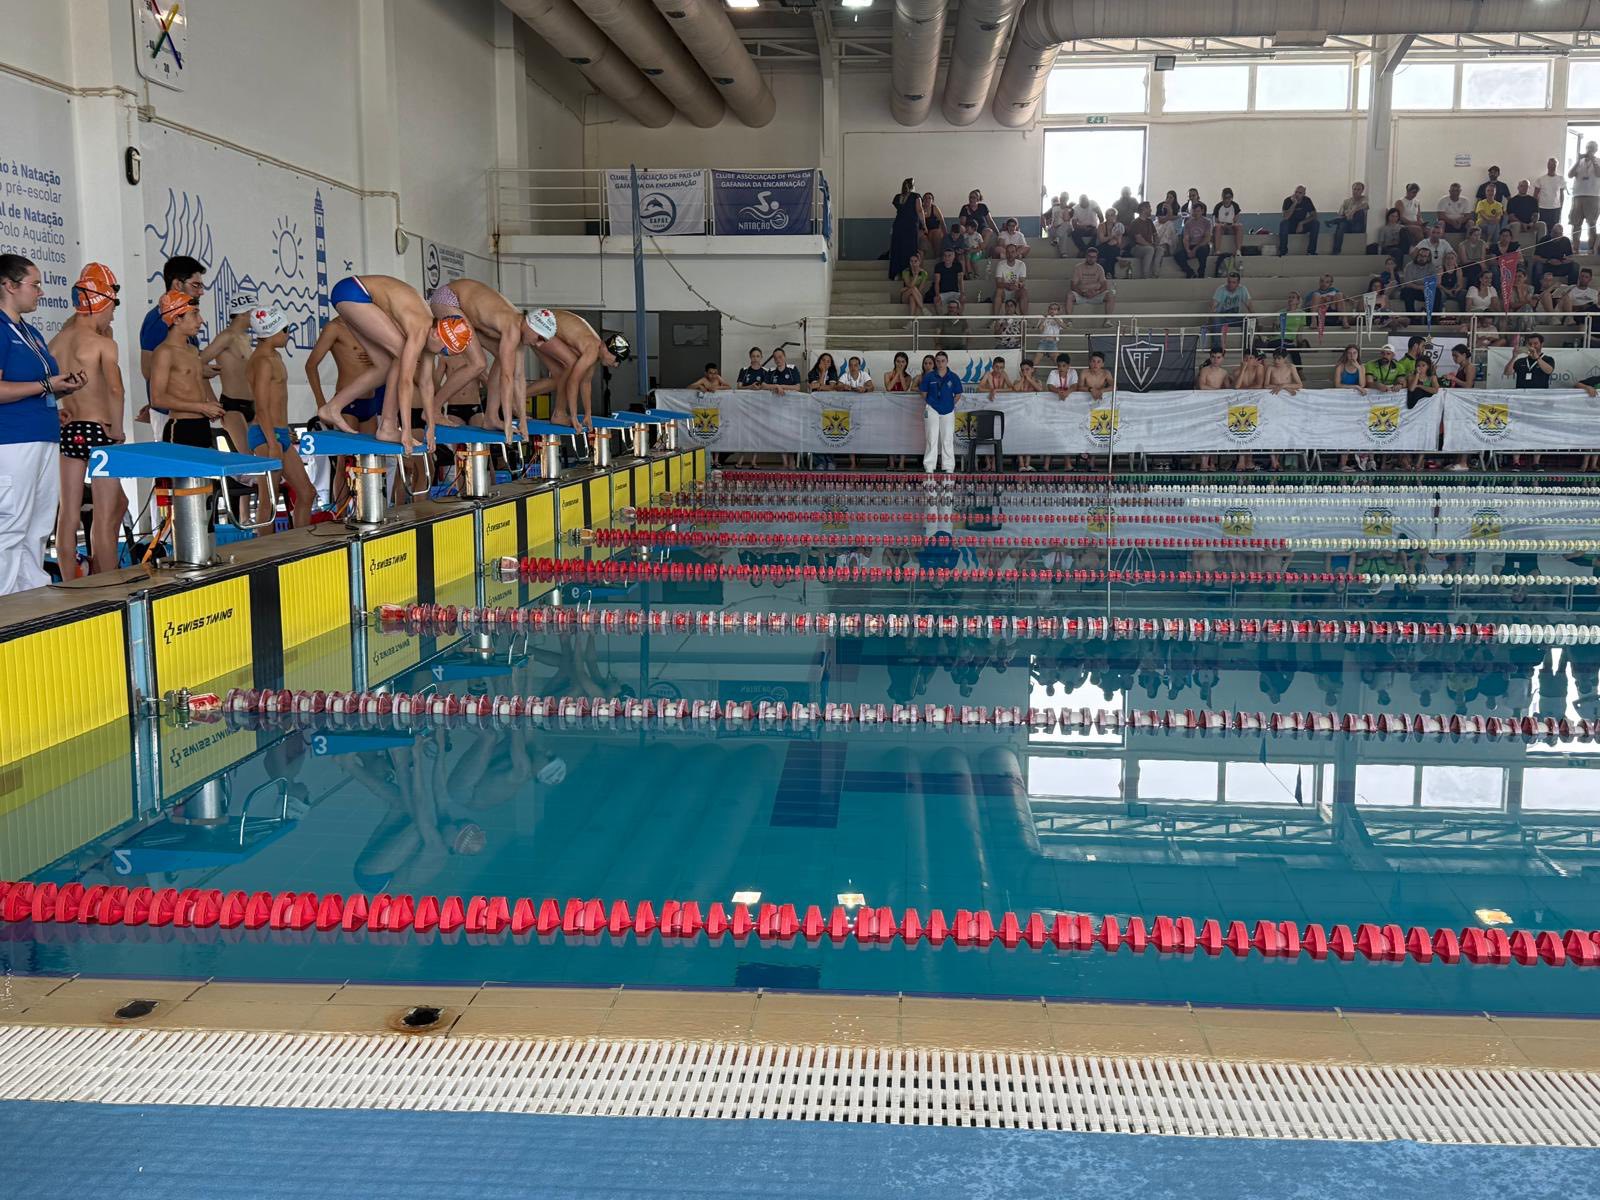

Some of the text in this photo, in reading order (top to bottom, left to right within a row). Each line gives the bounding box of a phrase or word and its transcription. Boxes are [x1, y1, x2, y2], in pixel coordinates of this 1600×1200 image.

[21, 164, 61, 187] Natação
[693, 170, 701, 178] DA
[6, 180, 62, 203] pré-escolar
[655, 180, 697, 189] ENCARNAÇÃO
[763, 180, 806, 188] ENCARNAÇÃO
[9, 203, 21, 219] de
[24, 207, 64, 228] Natação
[23, 225, 65, 246] Aquático
[738, 221, 771, 232] NATAÇÃO
[31, 246, 67, 264] adultos
[43, 270, 68, 287] Livre
[611, 412, 620, 420] 7
[301, 434, 316, 455] 3
[91, 449, 110, 477] 2
[176, 608, 234, 636] SWISS TIMING
